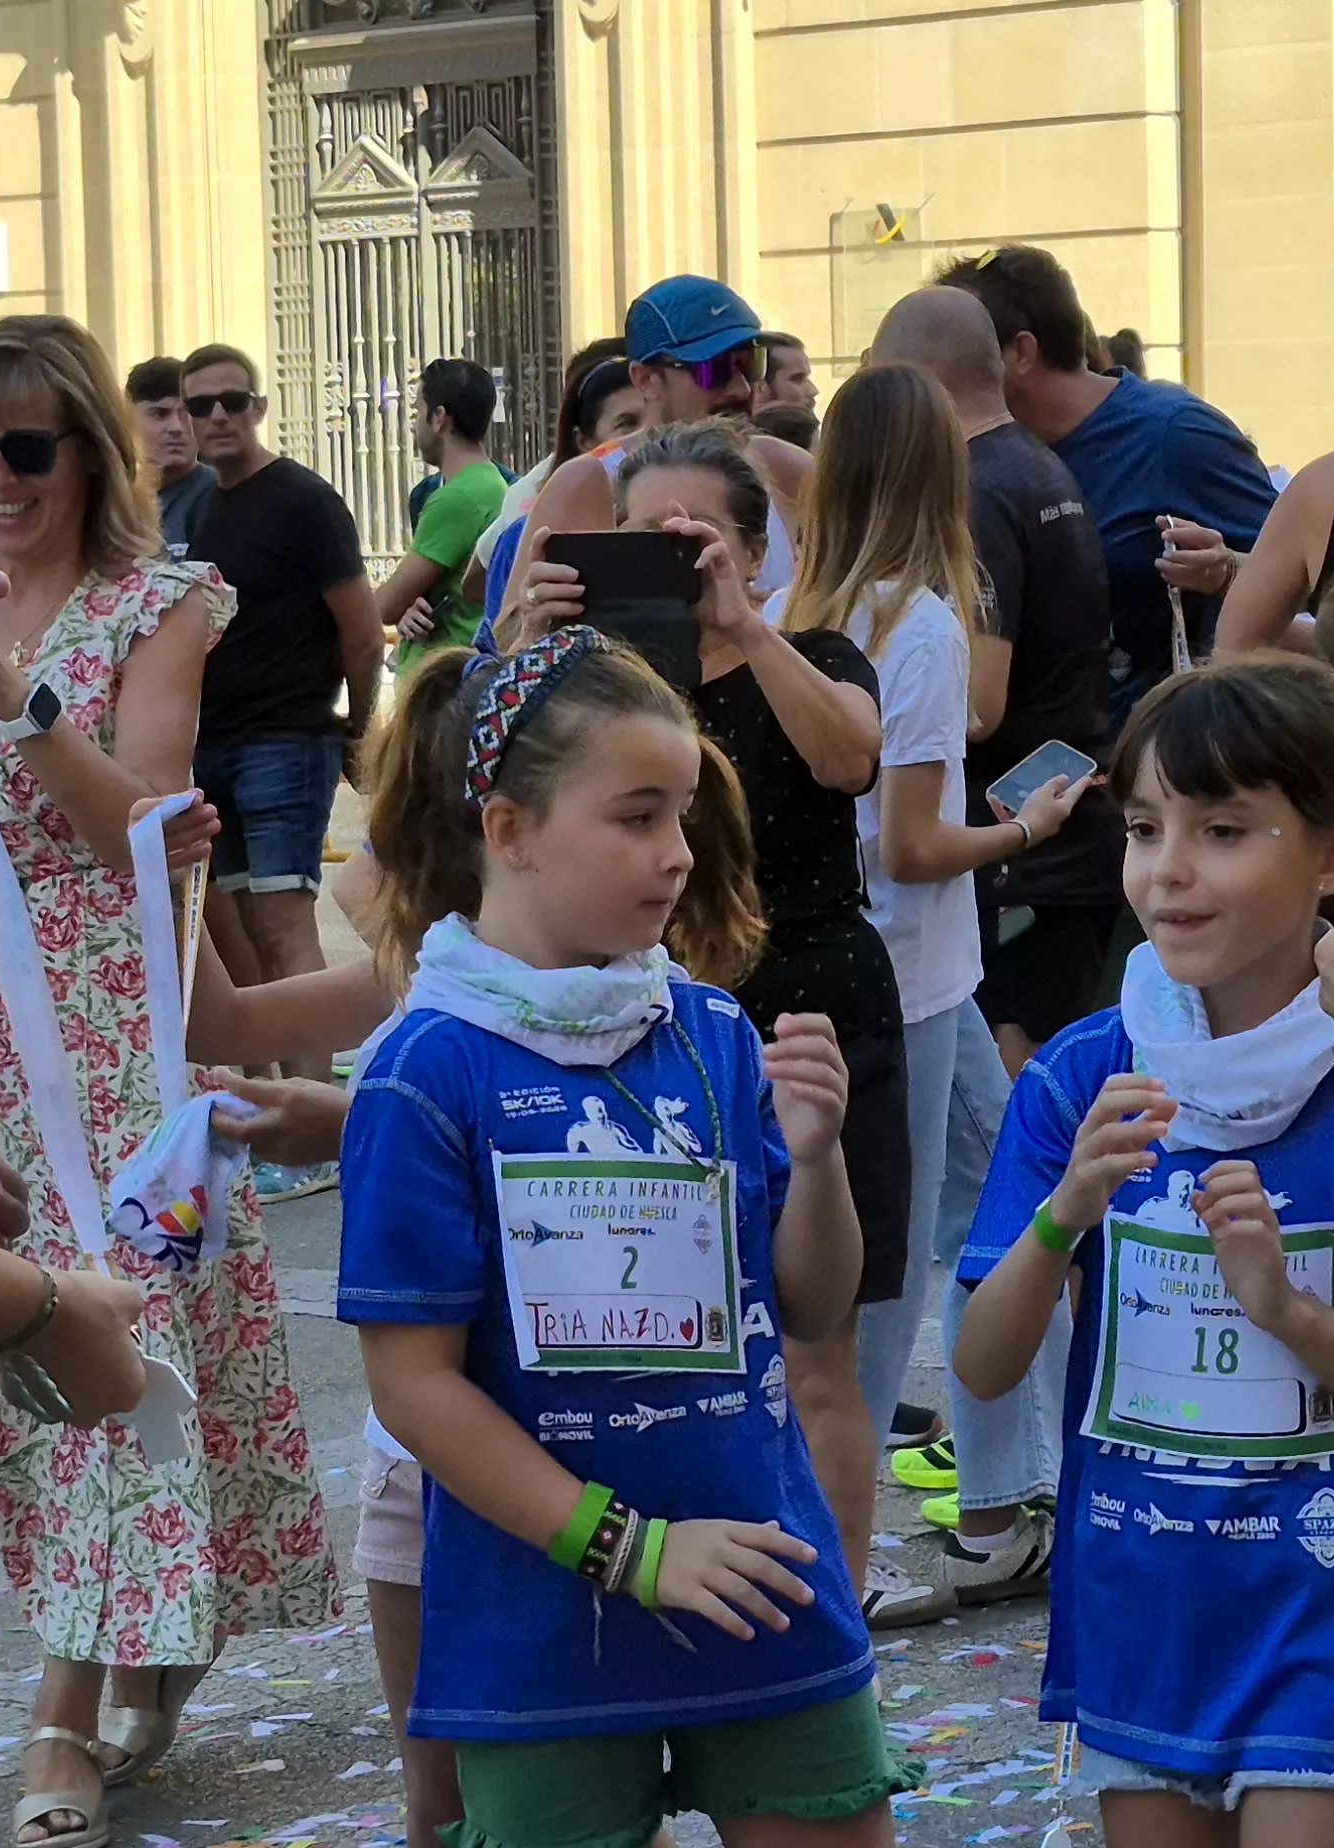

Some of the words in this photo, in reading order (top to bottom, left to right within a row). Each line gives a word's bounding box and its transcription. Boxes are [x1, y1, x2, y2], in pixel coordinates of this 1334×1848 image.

[527, 1180, 618, 1198] CARRERA
[629, 1181, 704, 1201] INFANTIL
[569, 1204, 615, 1220] CIUDAD
[620, 1205, 635, 1220] DE
[639, 1205, 678, 1221] HUESCA
[620, 1245, 639, 1290] 2
[1135, 1246, 1200, 1275] CARRERA
[1159, 1277, 1198, 1298] CIUDAD
[1202, 1283, 1219, 1299] DE
[1191, 1326, 1240, 1374] 18
[538, 1408, 593, 1426] embou
[1221, 1515, 1282, 1534] AMBAR
